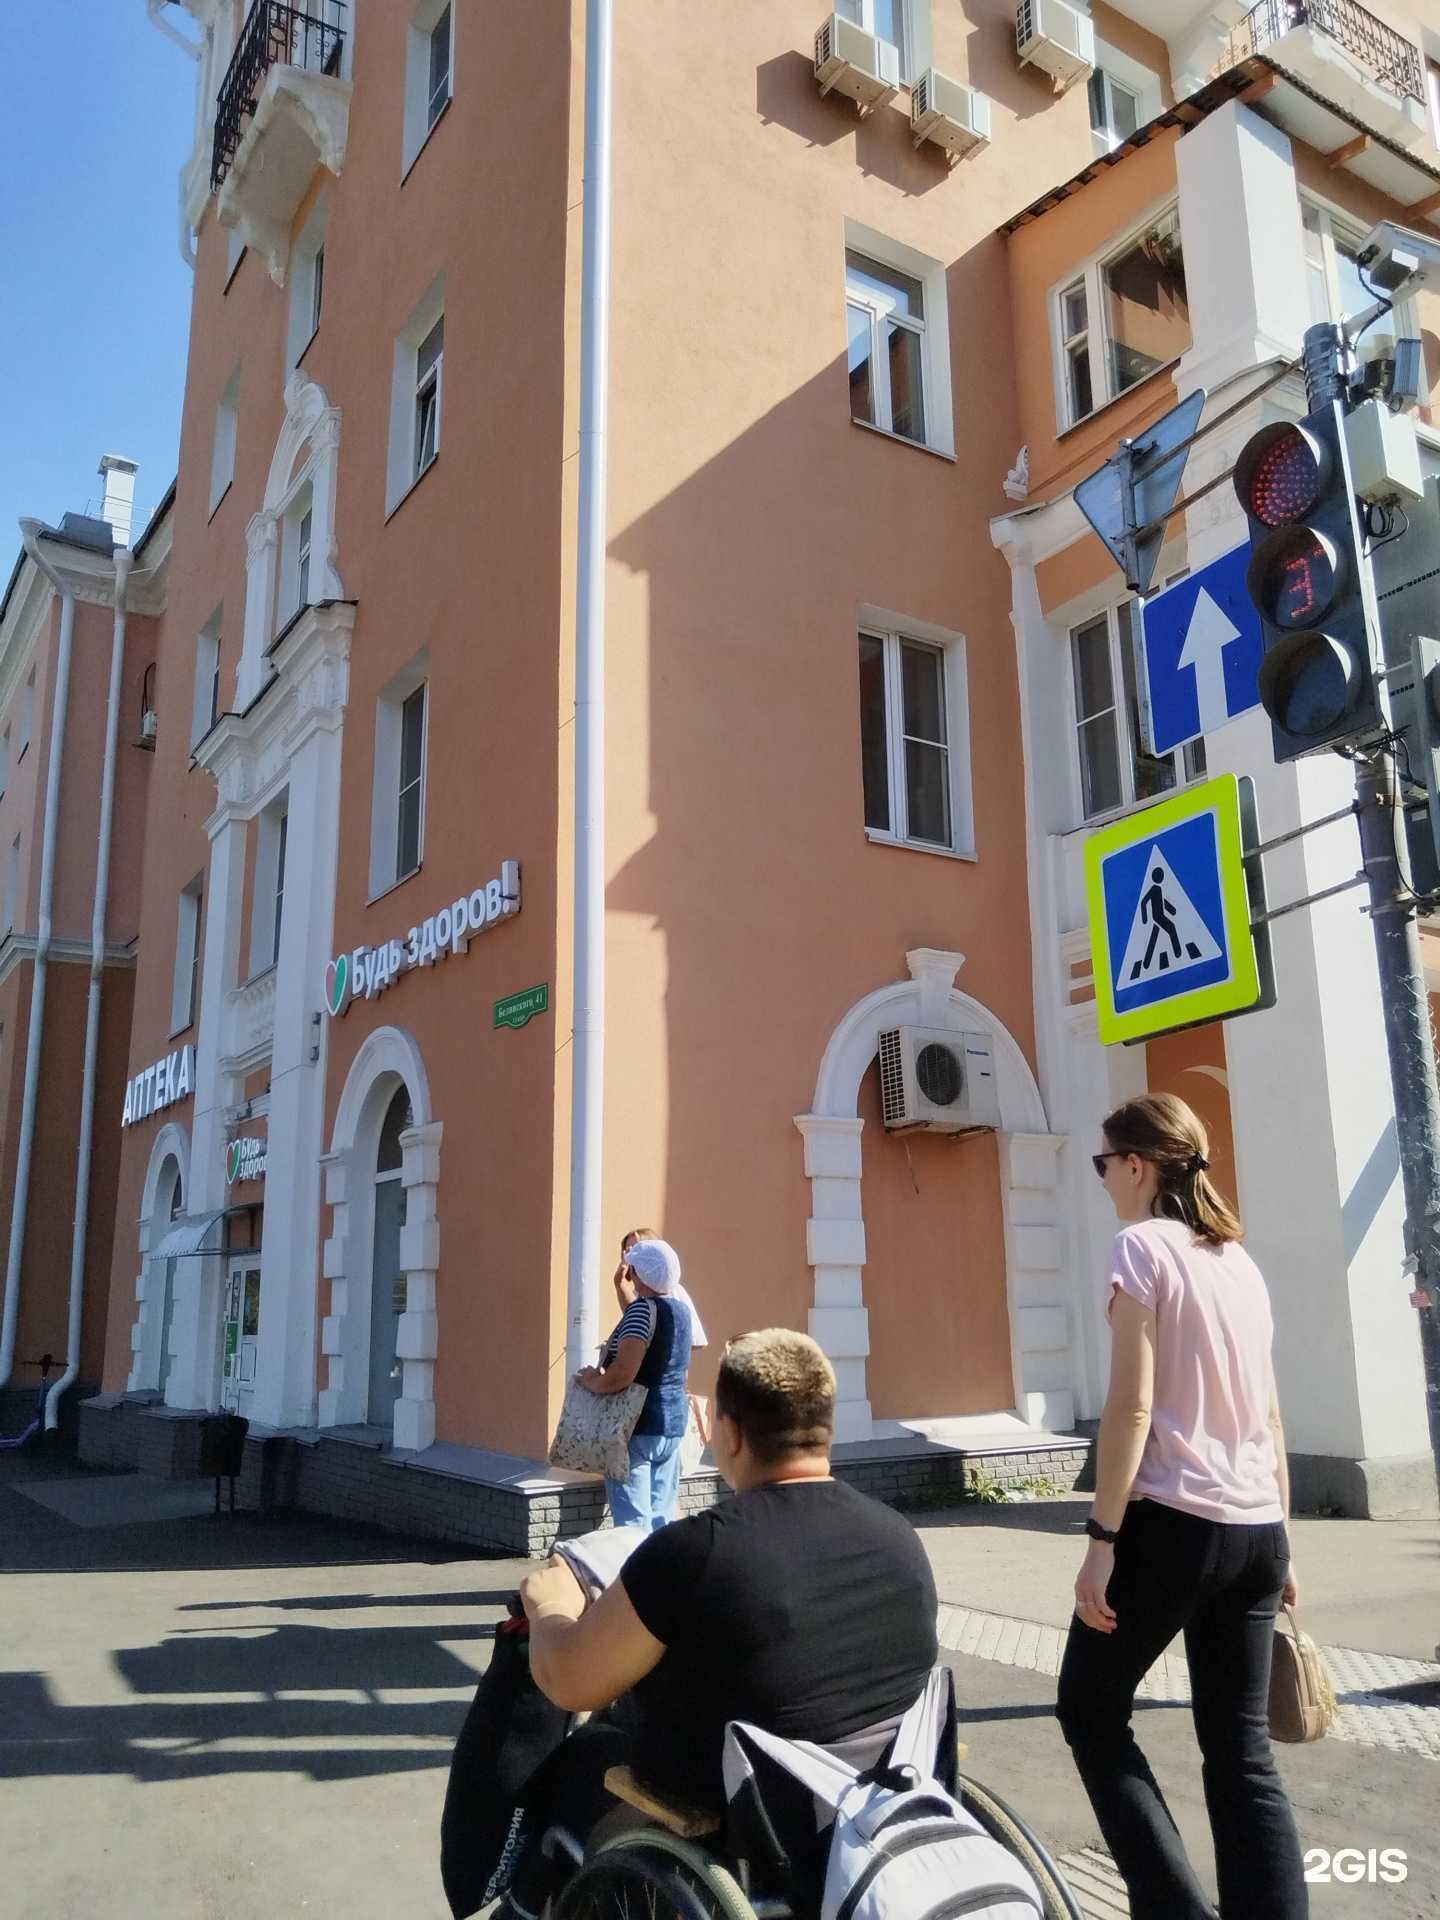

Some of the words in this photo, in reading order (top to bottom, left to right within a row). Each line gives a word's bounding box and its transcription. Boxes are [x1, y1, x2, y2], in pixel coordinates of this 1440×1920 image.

[352, 939, 403, 1000] Будь
[407, 861, 519, 967] здоров!
[121, 1044, 193, 1127] АПТЕКА
[241, 1138, 260, 1160] Будь
[481, 1807, 525, 1906] ТЕРРИТОРИЯ
